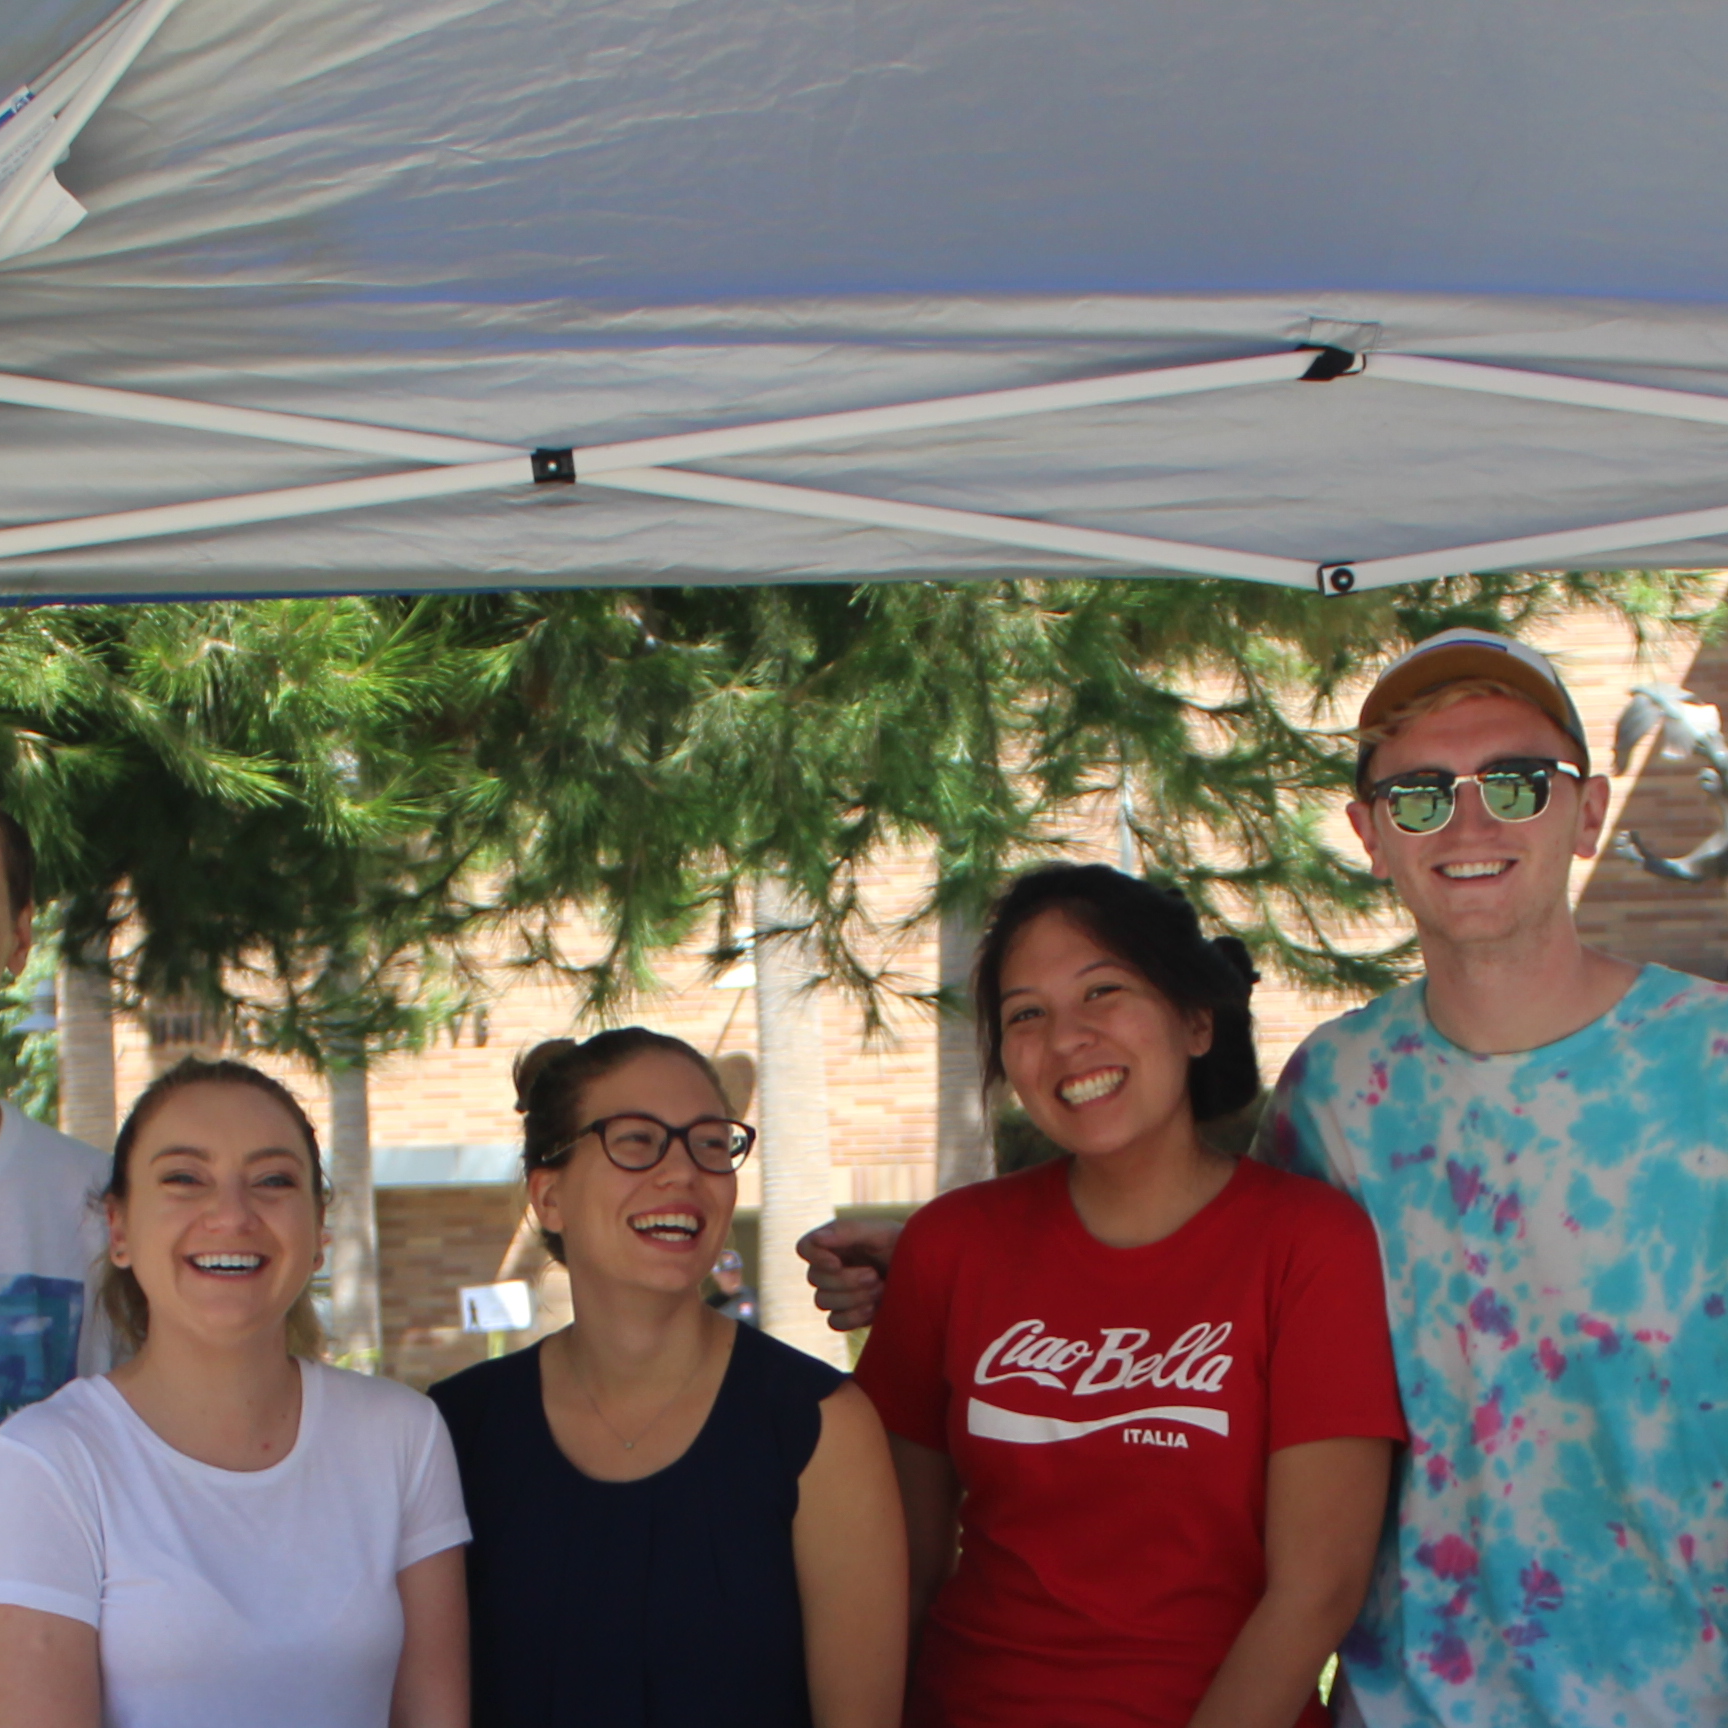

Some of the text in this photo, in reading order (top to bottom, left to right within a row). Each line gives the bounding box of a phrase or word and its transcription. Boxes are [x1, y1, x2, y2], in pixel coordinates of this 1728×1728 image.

[974, 1319, 1233, 1395] Ciao Bella
[1123, 1428, 1189, 1449] ITALIA
